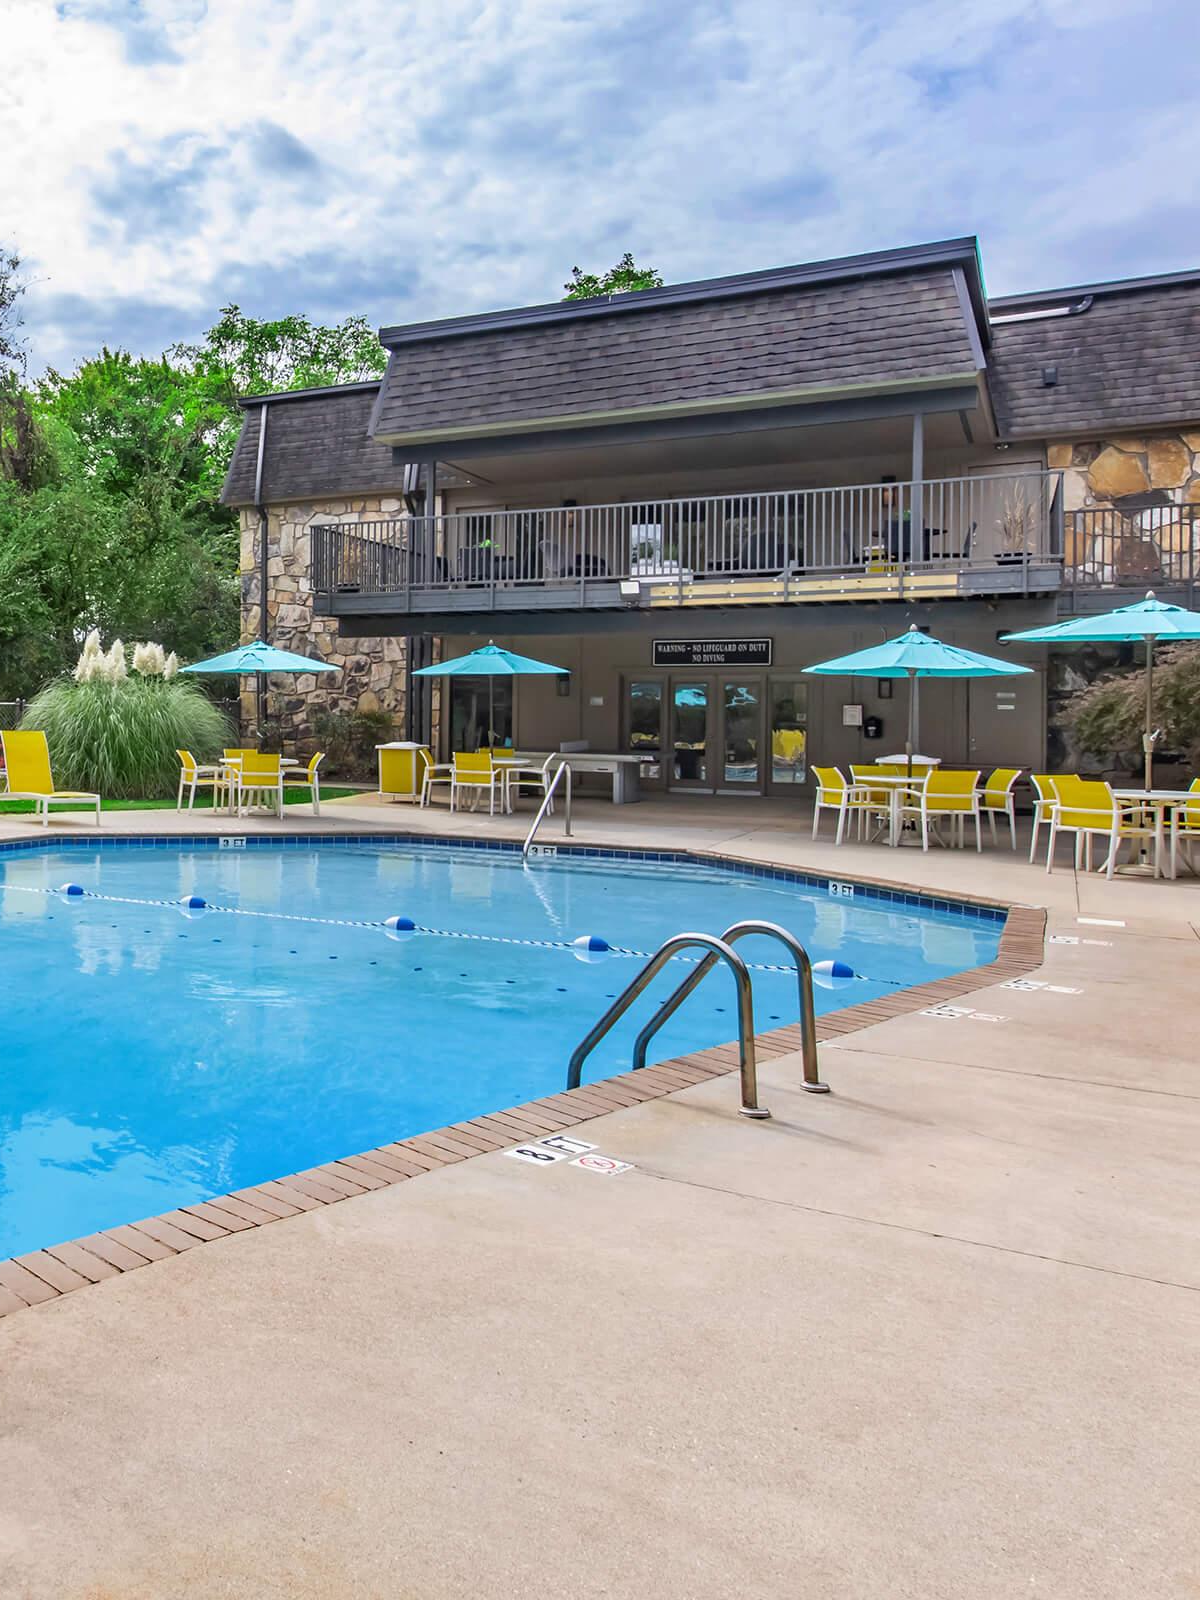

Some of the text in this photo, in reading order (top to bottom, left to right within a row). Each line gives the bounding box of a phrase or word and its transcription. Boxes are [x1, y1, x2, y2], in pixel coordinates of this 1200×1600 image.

[657, 644, 686, 652] WARNING
[692, 644, 701, 653] NO
[702, 643, 737, 652] LIFEGUARD
[738, 643, 748, 652] ON
[748, 643, 767, 652] DUTY
[692, 654, 725, 663] NO DIVING
[515, 1136, 591, 1161] 8 FT
